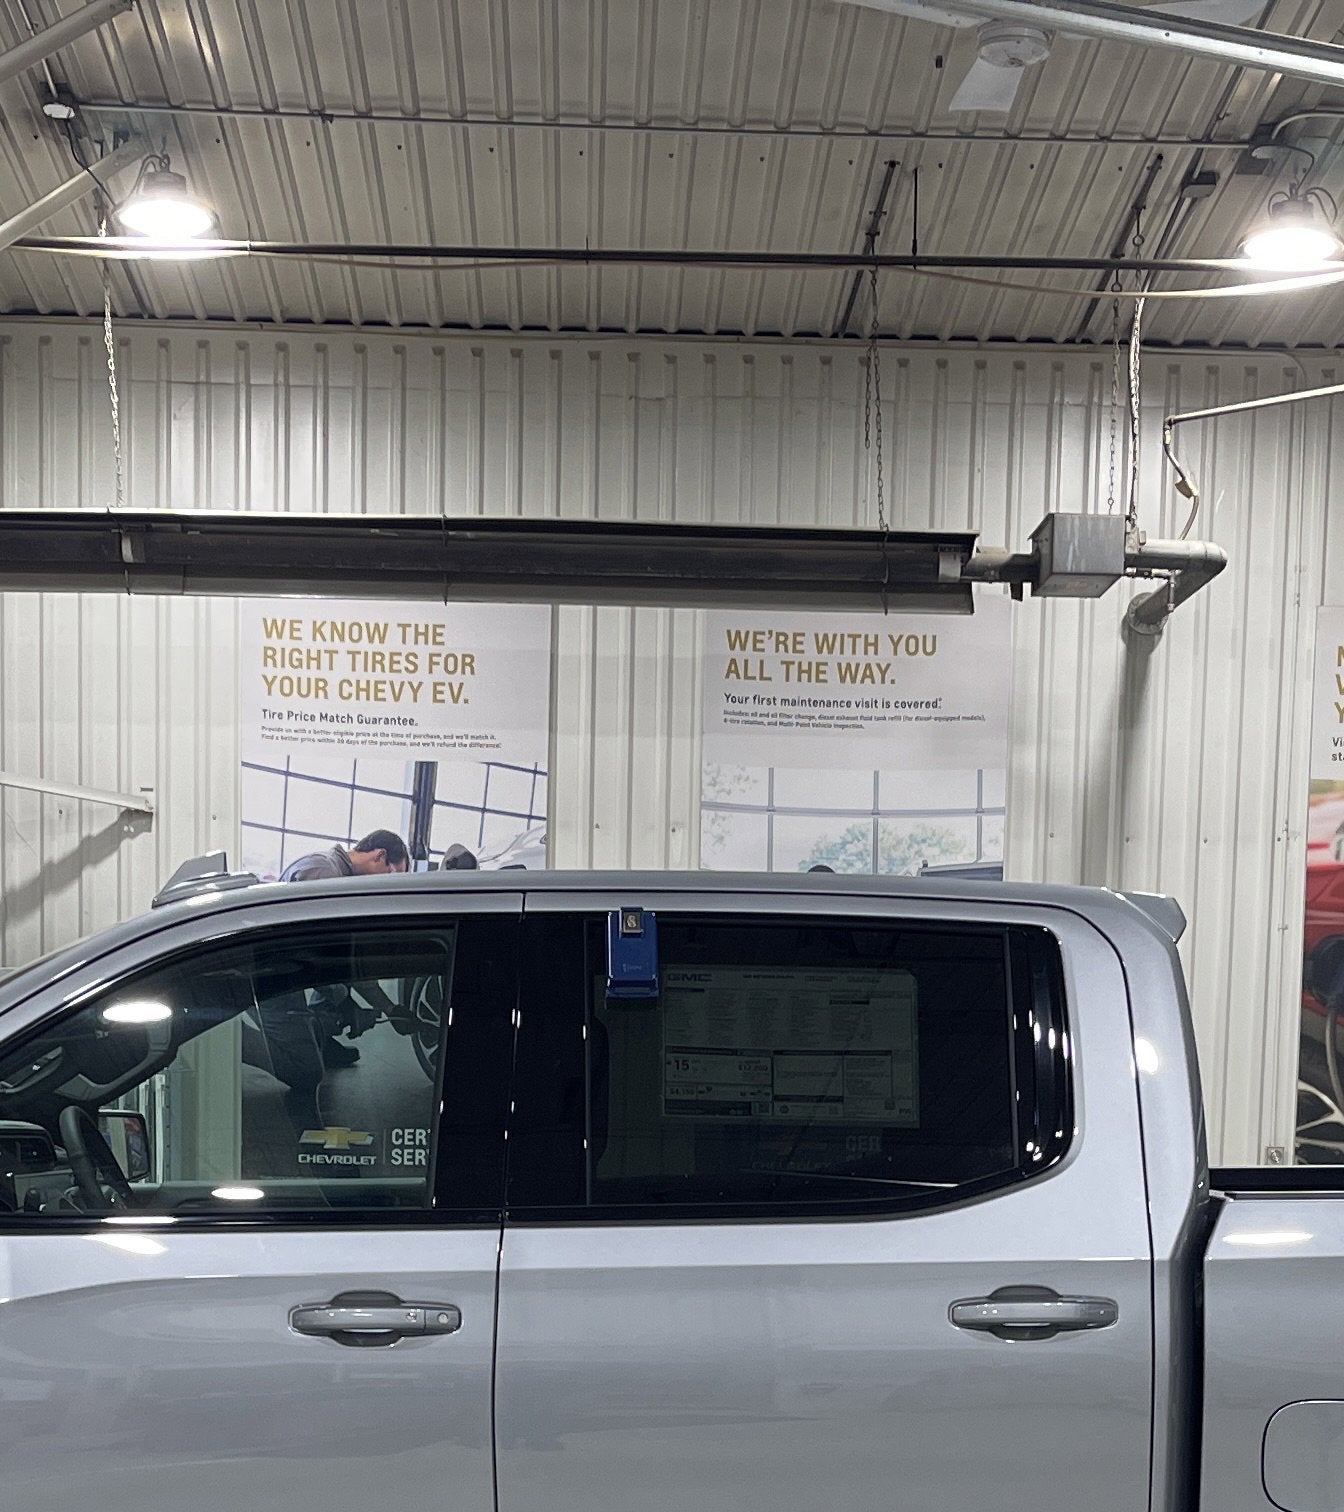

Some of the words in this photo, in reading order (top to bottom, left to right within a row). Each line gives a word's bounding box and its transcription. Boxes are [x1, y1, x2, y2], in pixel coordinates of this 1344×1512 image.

[262, 617, 303, 641] WE
[311, 620, 389, 645] KNOW
[397, 623, 446, 646] THE
[814, 632, 879, 656] WITH
[888, 633, 937, 656] YOU
[263, 646, 338, 671] RIGHT
[346, 650, 419, 674] TIRES
[428, 652, 475, 675] FOR
[724, 657, 772, 682] ALL
[780, 660, 829, 684] THE
[836, 662, 896, 685] WAY.
[262, 675, 329, 699] YOUR
[338, 679, 423, 703] CHEVY
[432, 681, 469, 704] EV.
[724, 692, 750, 705] Your
[752, 693, 777, 706] first
[780, 695, 852, 709] maintenance
[855, 697, 879, 709] visit
[881, 697, 891, 709] is
[262, 708, 284, 721] Tire
[287, 710, 316, 722] Price
[319, 712, 354, 725] Match
[357, 714, 419, 727] Guarantee.
[667, 973, 713, 982] GMC
[674, 1059, 690, 1071] 15
[298, 1154, 376, 1165] CHEVROLET
